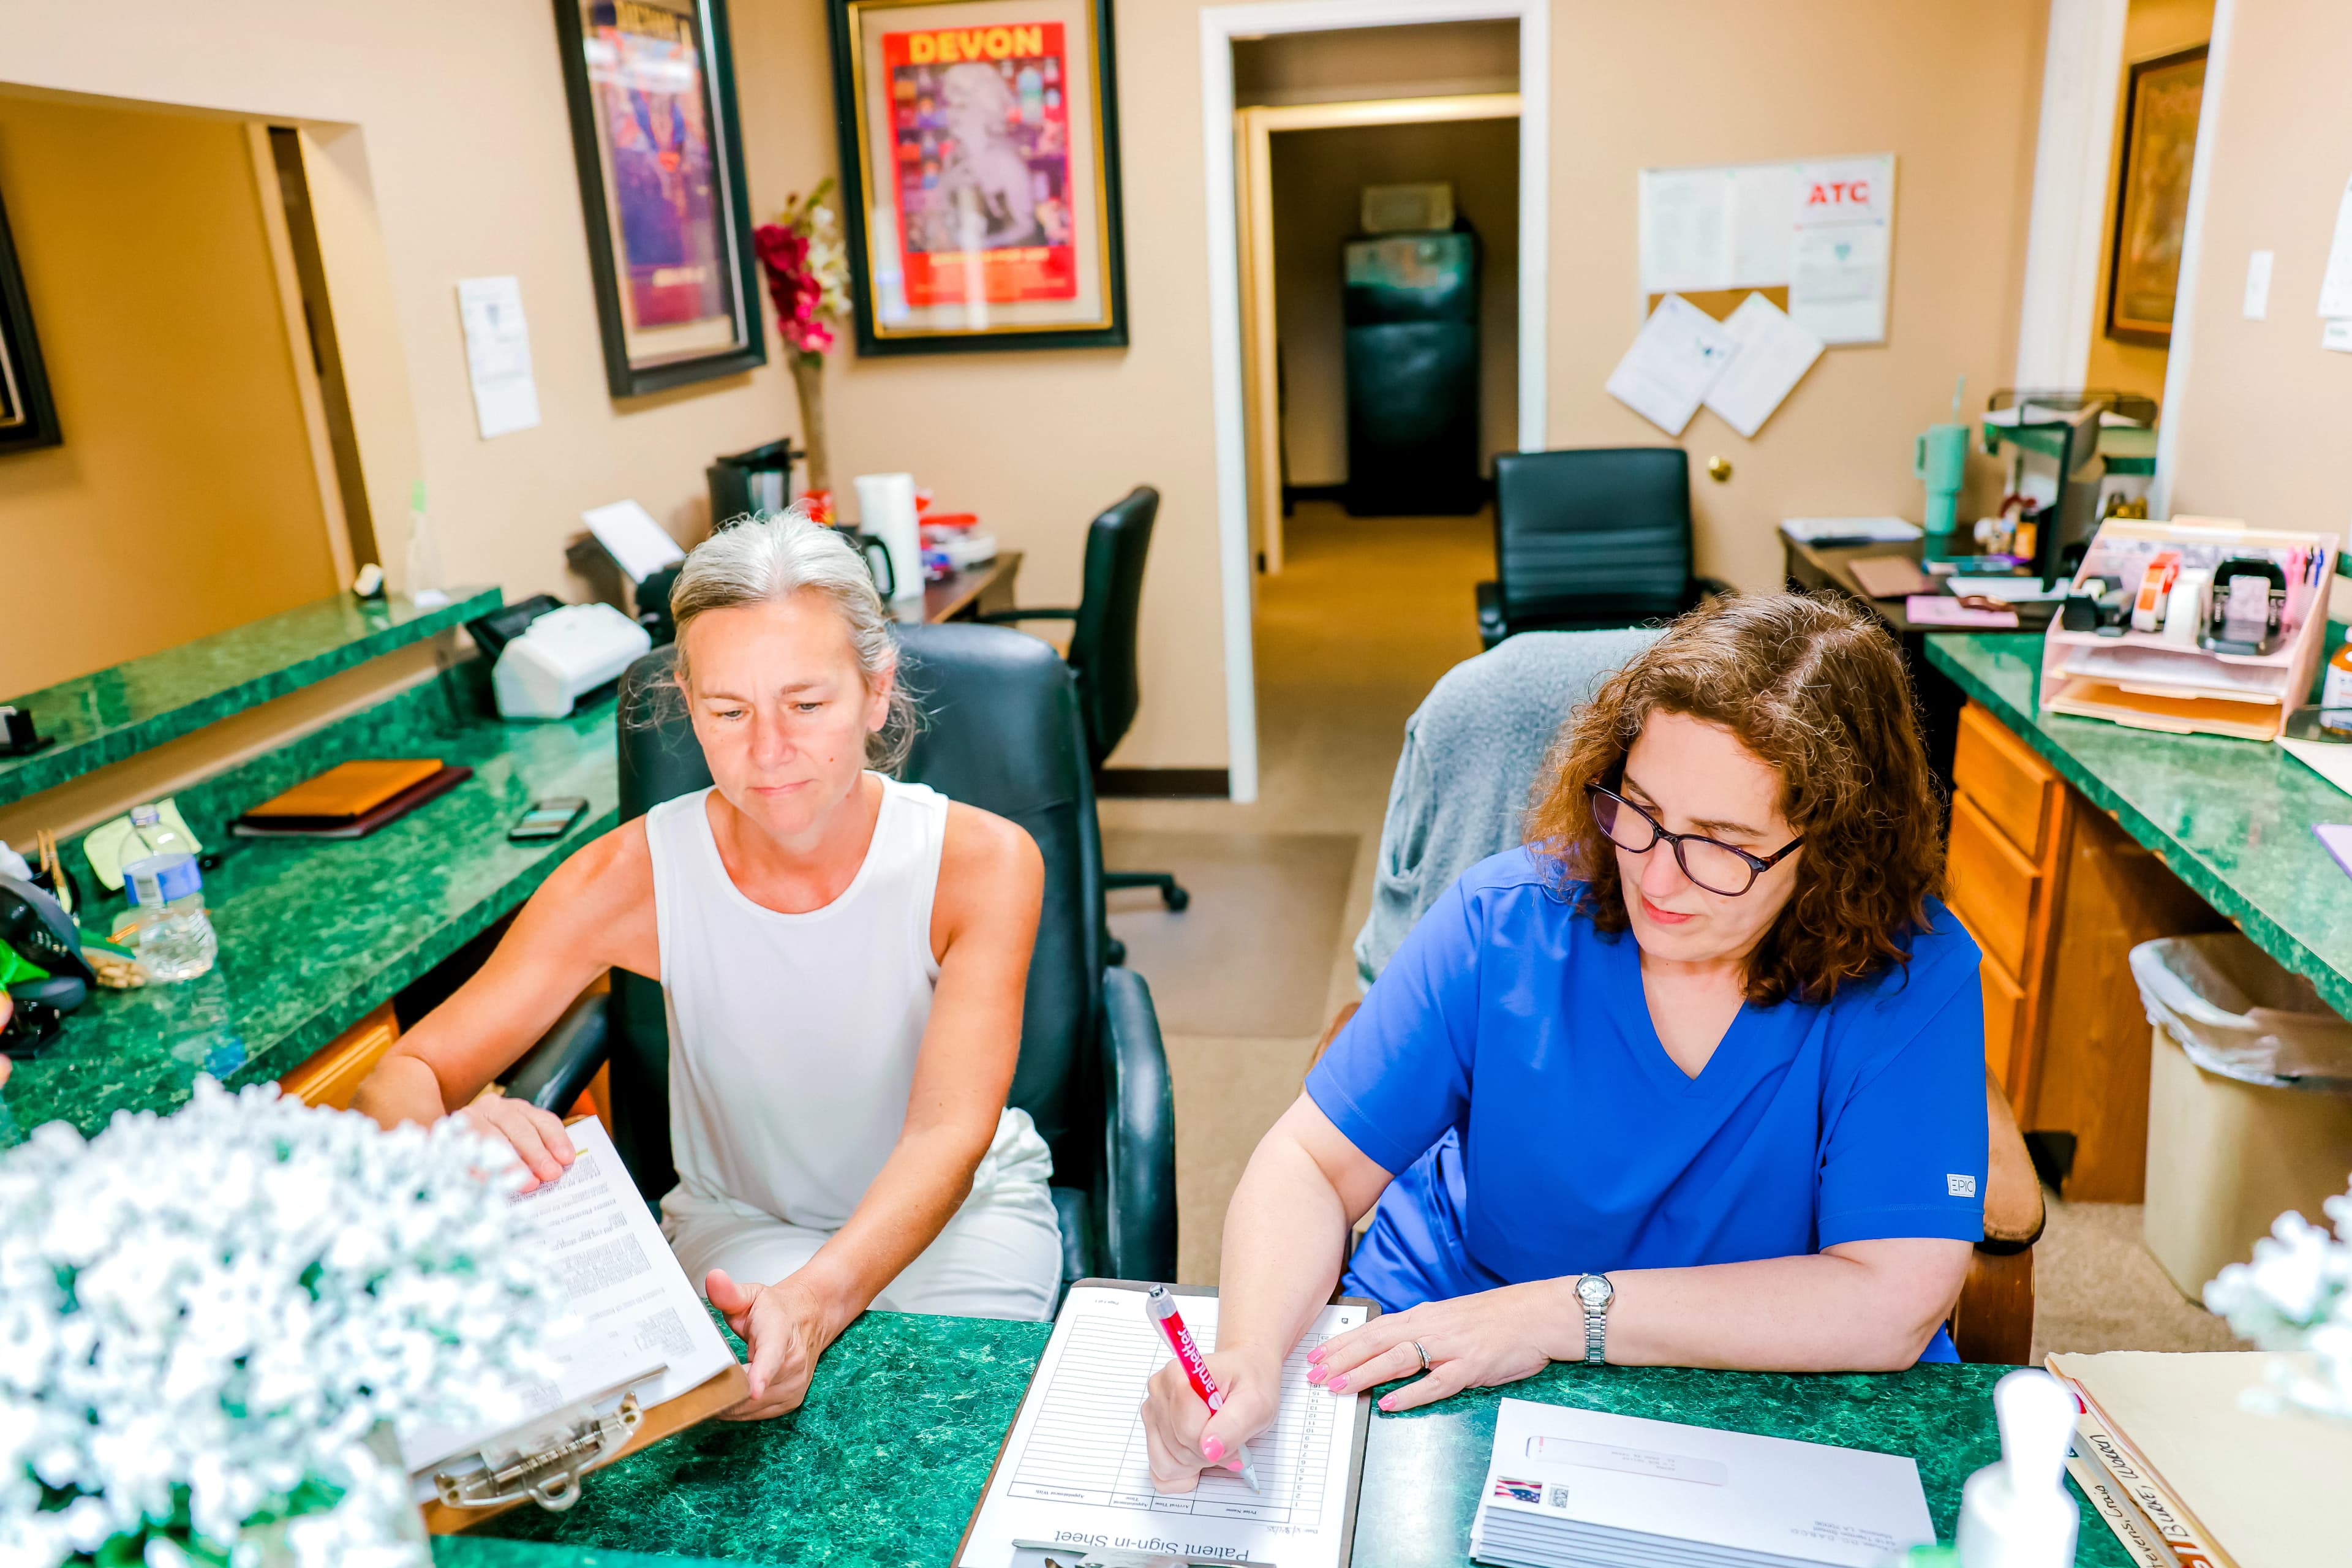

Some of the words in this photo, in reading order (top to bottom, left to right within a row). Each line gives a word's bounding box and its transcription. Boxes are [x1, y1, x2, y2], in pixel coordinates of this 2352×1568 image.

[910, 25, 1043, 66] DEVON
[1809, 180, 1869, 204] ATC
[1951, 1179, 1973, 1193] EPIC
[1050, 1490, 1085, 1499] Appointment
[1054, 1530, 1109, 1548] Sheet
[1115, 1537, 1178, 1555] Sign-in
[2121, 1520, 2165, 1568] tevens,
[1185, 1544, 1250, 1562] Patient
